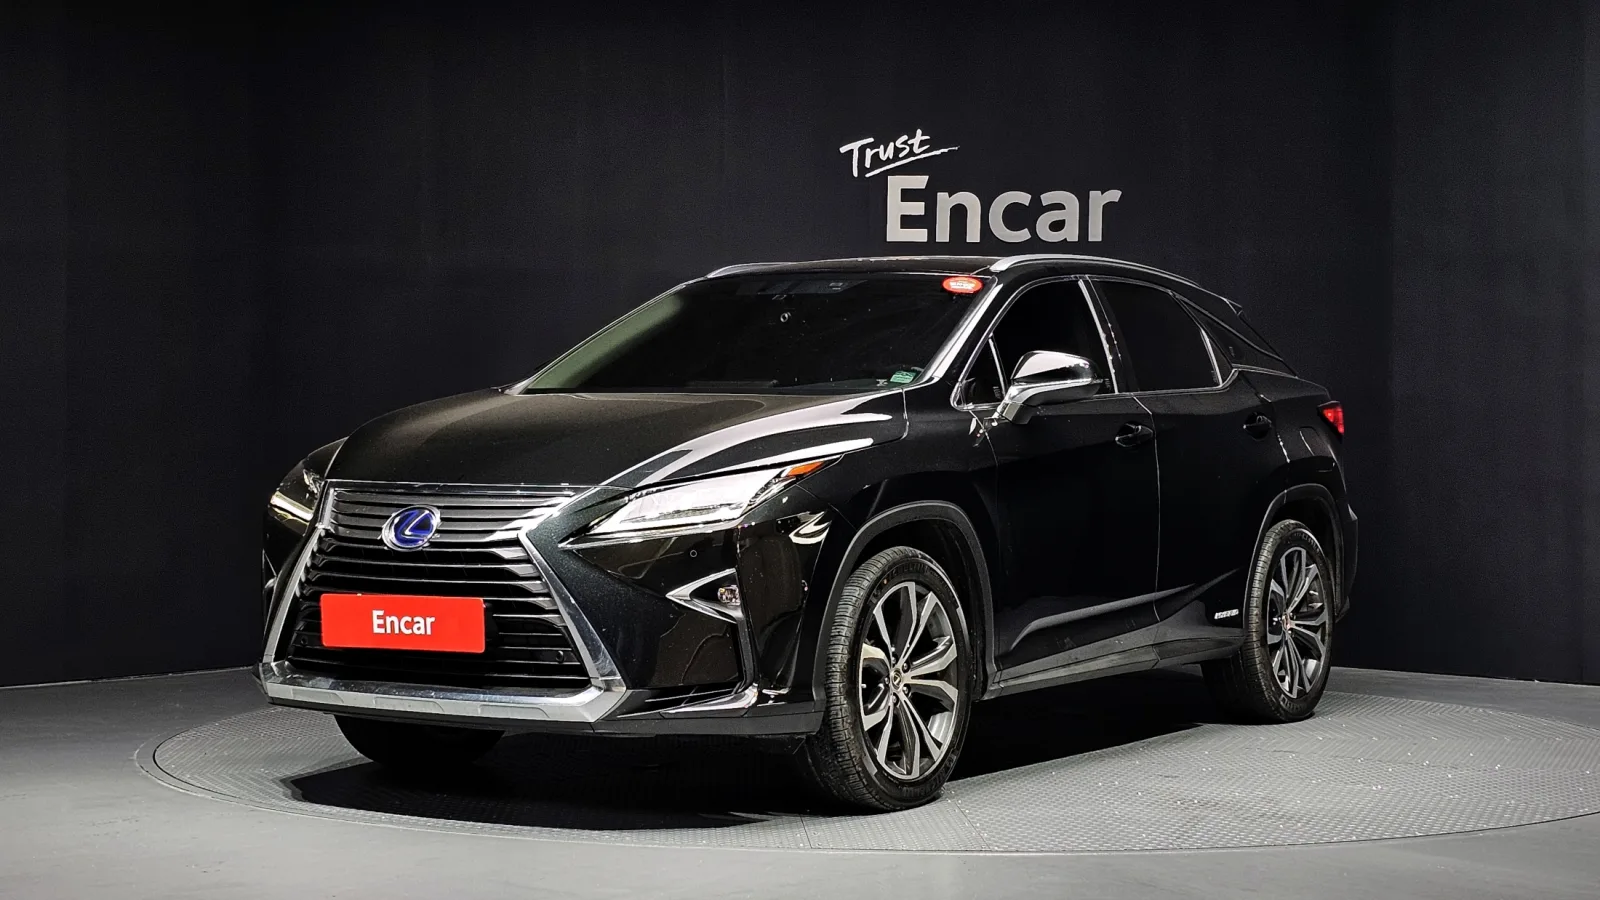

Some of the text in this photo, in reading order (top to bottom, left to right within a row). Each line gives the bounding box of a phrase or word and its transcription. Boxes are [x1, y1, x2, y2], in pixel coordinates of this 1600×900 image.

[839, 128, 932, 178] Trust
[886, 175, 1123, 243] Encar
[371, 609, 436, 635] Encar
